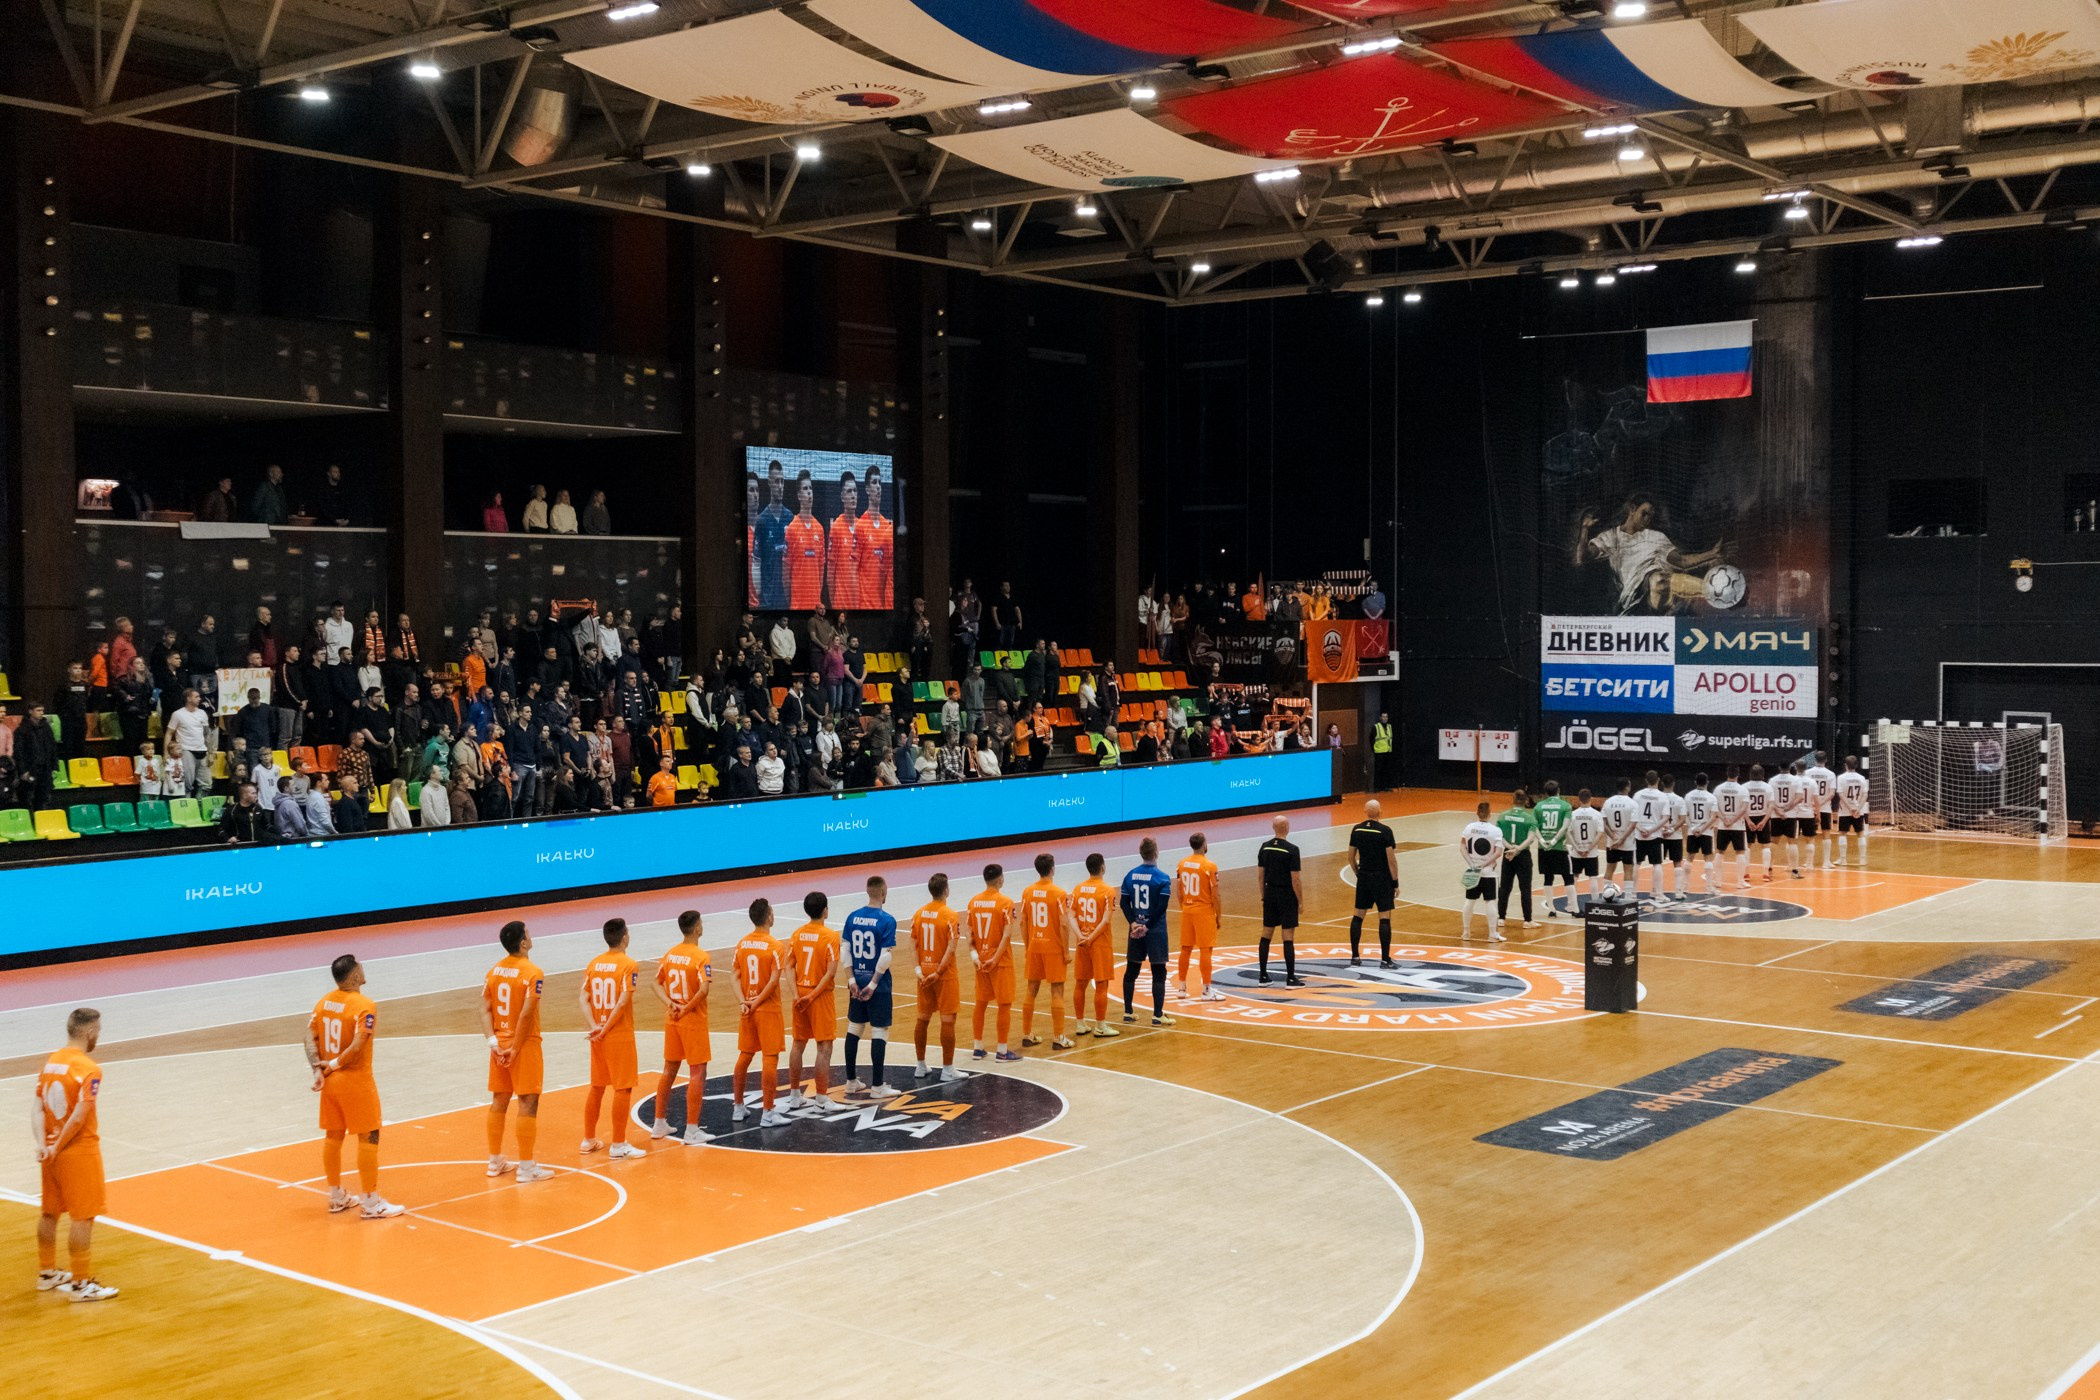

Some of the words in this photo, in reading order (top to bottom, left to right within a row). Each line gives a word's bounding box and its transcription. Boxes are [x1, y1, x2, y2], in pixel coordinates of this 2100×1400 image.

[794, 84, 843, 101] UNION
[1547, 631, 1670, 652] ДНЕВНИК
[1714, 631, 1811, 651] МЯЧ
[1545, 677, 1670, 698] БЕТСИТИ
[1694, 672, 1796, 694] APOLLO
[1750, 696, 1796, 713] genio
[1545, 719, 1669, 752] JÖGEL
[1708, 734, 1813, 750] superliga.rfs.ru
[1724, 796, 1736, 812] 21
[1750, 795, 1765, 811] 29
[1778, 787, 1789, 803] 19
[1847, 786, 1861, 801] 47
[1542, 811, 1559, 829] 30
[1614, 810, 1622, 828] 9
[1643, 802, 1652, 819] 4
[1693, 803, 1704, 820] 15
[1511, 823, 1517, 843] 1
[1580, 823, 1588, 840] 8
[1181, 872, 1200, 896] 90
[1133, 884, 1150, 909] 13
[1030, 902, 1049, 928] 18
[1078, 897, 1097, 923] 39
[1588, 907, 1618, 917] JÖGEL
[975, 912, 993, 939] 17
[851, 929, 876, 960] 83
[921, 923, 935, 951] 11
[803, 946, 814, 976] 7
[1437, 951, 1504, 963] BE
[747, 954, 759, 985] 8
[591, 977, 617, 1010] 80
[668, 968, 689, 1000] 21
[497, 982, 511, 1017] 9
[1206, 1004, 1283, 1018] BE
[1292, 1012, 1462, 1025] HARD
[322, 1016, 342, 1054] 19
[1632, 1056, 1791, 1112] #novaarena
[1556, 1134, 1607, 1151] NOVA
[1598, 1117, 1651, 1136] ARENA
